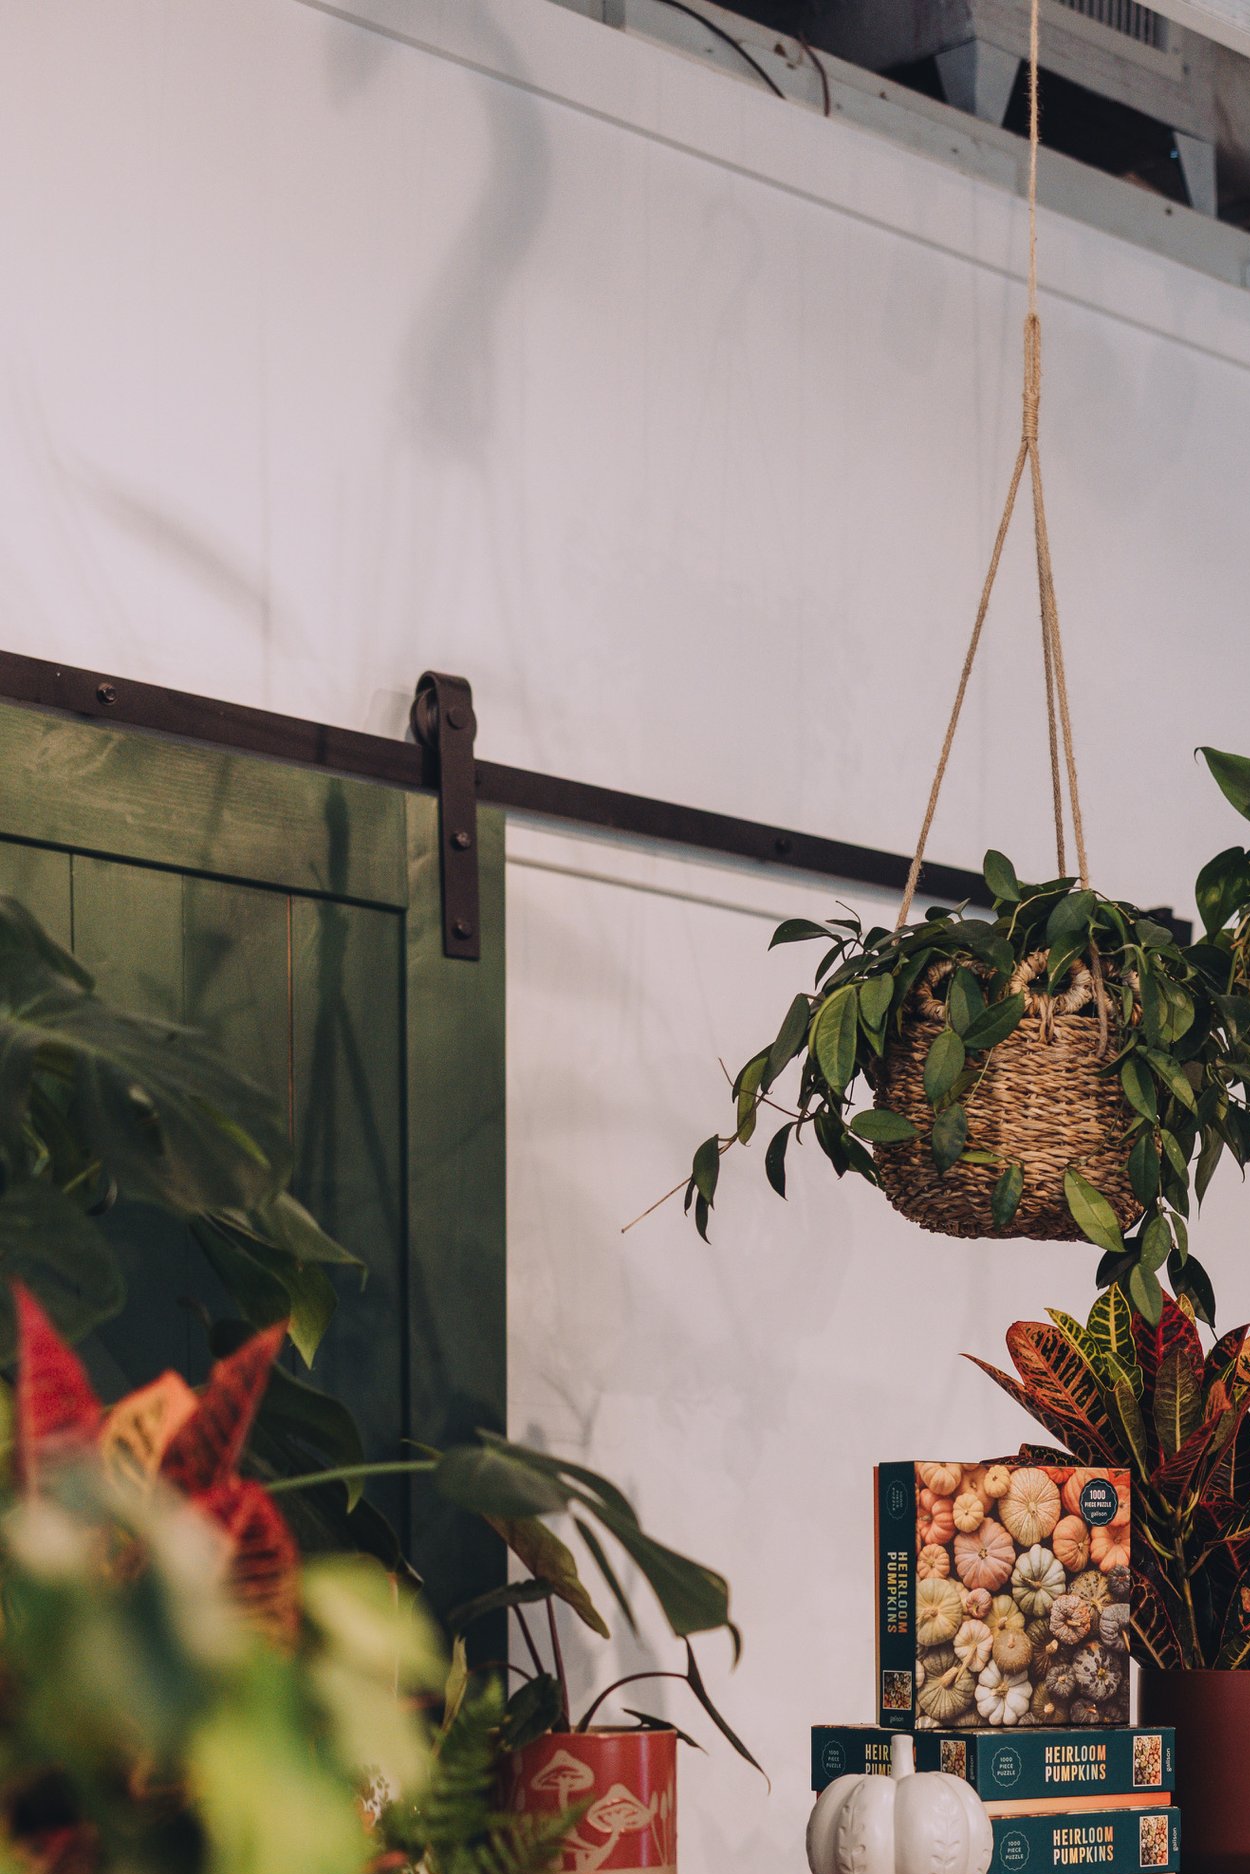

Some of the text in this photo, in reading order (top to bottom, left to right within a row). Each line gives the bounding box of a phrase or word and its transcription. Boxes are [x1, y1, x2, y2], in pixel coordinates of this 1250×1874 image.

[1089, 1489, 1106, 1500] 1000
[887, 1551, 897, 1633] PUMPKINS
[898, 1551, 908, 1633] HEIRLOOM
[1045, 1744, 1107, 1763] HEIRLOOM
[1045, 1763, 1106, 1783] PUMPKINS
[1053, 1826, 1114, 1847] HEIRLOOM
[1053, 1845, 1114, 1866] PUMPKINS
